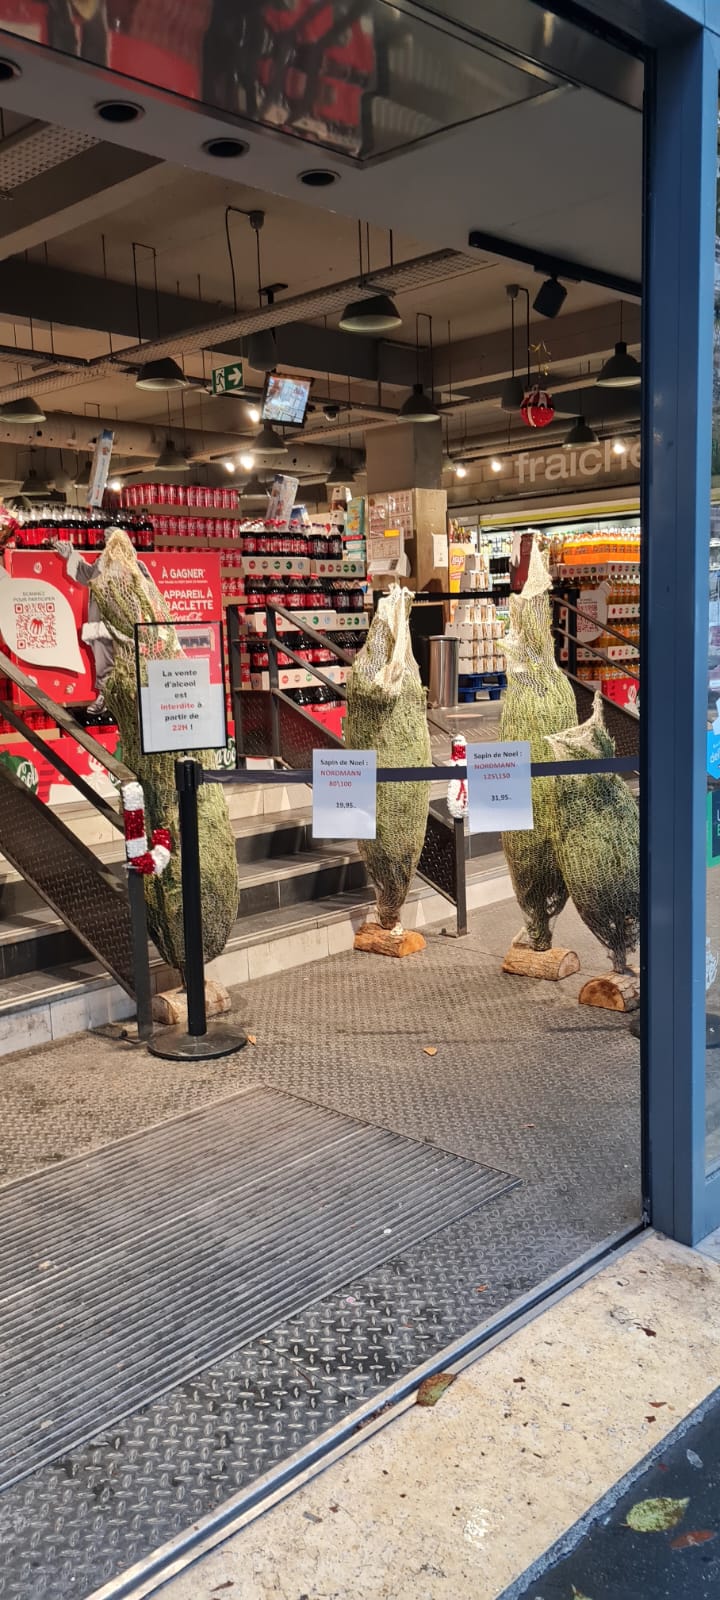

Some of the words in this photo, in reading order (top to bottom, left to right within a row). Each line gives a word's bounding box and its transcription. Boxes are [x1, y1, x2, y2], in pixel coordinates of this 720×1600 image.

[162, 566, 168, 579] À
[163, 589, 205, 600] APPAREIL
[206, 586, 214, 599] À
[162, 669, 173, 678] La
[174, 669, 197, 678] vente
[164, 679, 196, 688] d'alcool
[160, 702, 195, 711] interdite
[197, 701, 203, 709] à
[164, 713, 188, 722] partir
[189, 711, 199, 720] de
[171, 724, 188, 732] 22H
[473, 752, 492, 760] Sapin
[474, 762, 516, 770] NORDMANN
